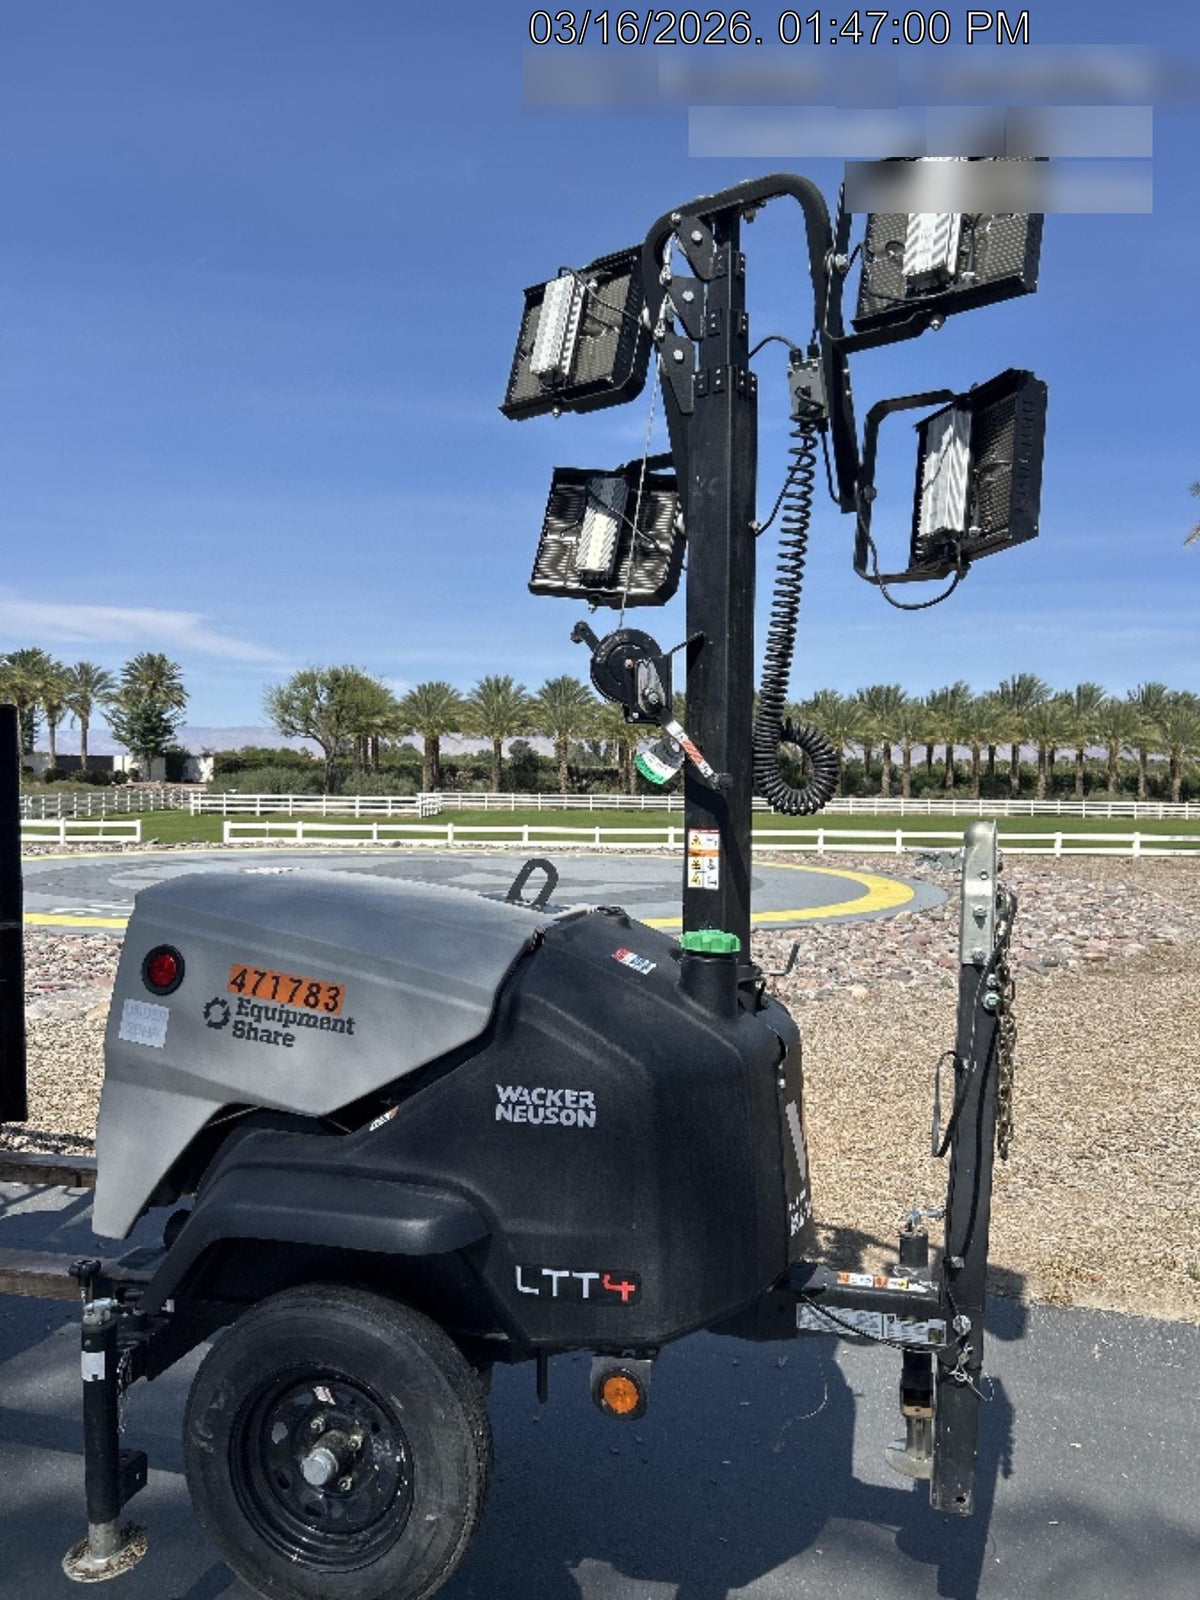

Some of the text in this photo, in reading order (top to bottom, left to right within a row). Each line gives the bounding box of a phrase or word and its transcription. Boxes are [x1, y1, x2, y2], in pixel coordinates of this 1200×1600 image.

[229, 968, 342, 1013] 471783
[235, 997, 356, 1035] Equipment
[232, 1020, 296, 1047] Share
[495, 1083, 597, 1110] WACKER
[495, 1103, 597, 1128] NEUSON
[515, 1265, 636, 1302] LTT4
